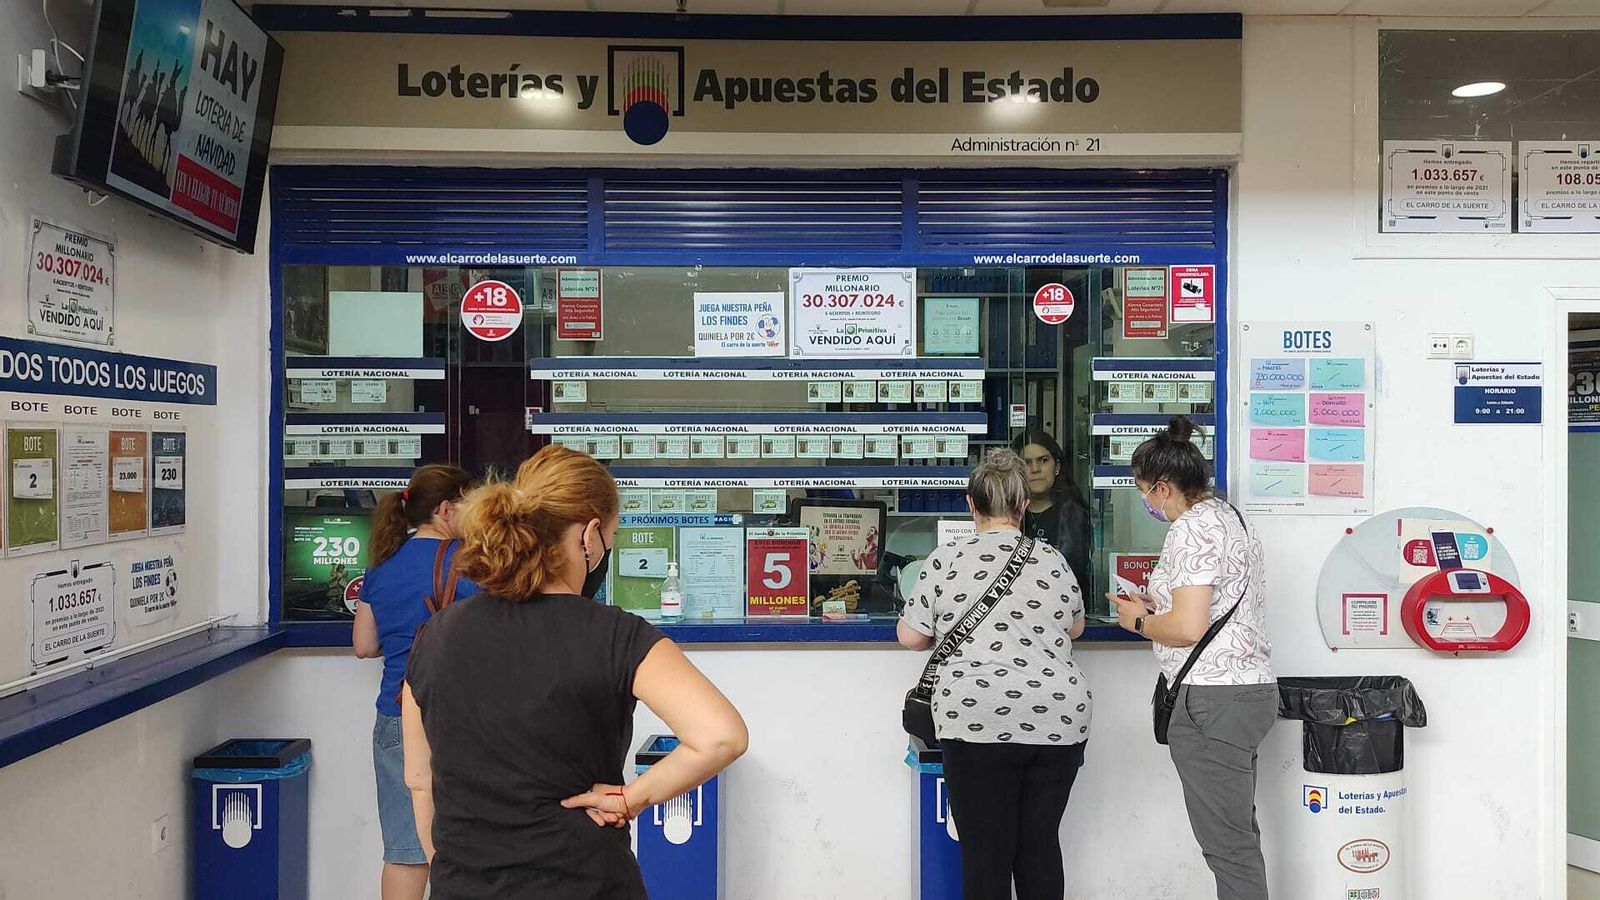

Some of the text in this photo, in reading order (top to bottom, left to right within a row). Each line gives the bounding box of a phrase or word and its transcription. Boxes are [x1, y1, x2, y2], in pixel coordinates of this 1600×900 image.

[201, 20, 257, 103] HAY
[398, 63, 1100, 109] Loterías y Apuestas del Estado
[232, 121, 246, 143] DE
[951, 138, 1061, 152] Administración
[1086, 138, 1101, 152] 21
[195, 134, 236, 176] NAVIDAD
[1411, 168, 1478, 181] 1.033.657
[65, 233, 88, 248] PREMIO
[55, 244, 94, 262] MILLONARIO
[406, 253, 577, 264] www.elcarrodelasuerte.com
[973, 253, 1140, 264] www.elcarrodelasuerte.com
[37, 251, 104, 285] 30.307.024
[836, 274, 869, 282] PREMIO
[825, 284, 880, 292] MILLONARIO
[474, 287, 508, 307] +18
[1042, 288, 1064, 301] +18
[699, 301, 772, 312] JUEGA NUESTRA PEÑA
[802, 294, 895, 308] 30.307.024
[39, 309, 104, 331] VENDIDO AQUÍ
[702, 316, 748, 326] LOS FINDES
[698, 332, 728, 341] QUINIELA
[730, 332, 745, 341] POR
[809, 333, 896, 345] VENDIDO AQUÍ
[1283, 330, 1332, 349] BOTES
[47, 355, 110, 388] TODOS
[115, 363, 146, 391] LOS
[150, 368, 205, 396] JUEGOS
[321, 368, 361, 377] LOTERÍA
[552, 369, 590, 378] LOTERÍA
[663, 369, 700, 378] LOTERÍA
[772, 370, 809, 378] LOTERÍA
[880, 370, 917, 378] LOTERÍA
[1112, 371, 1149, 379] LOTERÍA
[11, 401, 180, 420] BOTE BOTE BOTE BOTE
[1254, 407, 1297, 417] 2.000.000
[1313, 407, 1360, 418] 5.000.000
[321, 424, 361, 433] LOTERÍA
[553, 424, 591, 433] LOTERÍA
[664, 424, 702, 433] LOTERÍA
[774, 425, 811, 433] LOTERÍA
[882, 425, 919, 433] LOTERÍA
[1111, 425, 1149, 433] LOTERÍA
[23, 436, 42, 452] BOTE
[121, 437, 136, 451] BOTE
[162, 438, 176, 451] BOTE
[119, 471, 137, 480] 23.000
[161, 468, 177, 481] 230
[29, 473, 37, 489] 2
[320, 477, 409, 487] LOTERÍA NACIONAL
[664, 478, 702, 487] LOTERÍA
[773, 478, 811, 486] LOTERÍA
[882, 478, 919, 486] LOTERÍA
[631, 514, 679, 525] PRÓXIMOS
[681, 516, 709, 524] BOTES
[632, 532, 655, 543] BOTE
[313, 536, 360, 558] 230
[313, 557, 358, 565] MILLONES
[638, 559, 648, 570] 2
[1123, 561, 1150, 570] BONO
[762, 553, 792, 589] 5
[133, 573, 161, 589] LOS FINDES
[48, 588, 97, 612] 1.033.657
[750, 596, 806, 605] MILLONES
[45, 628, 105, 651] EL CARRO DE LA SUERTE
[1338, 791, 1375, 800] Loterías
[1376, 793, 1382, 801] y
[1338, 805, 1386, 814] del Estado.
